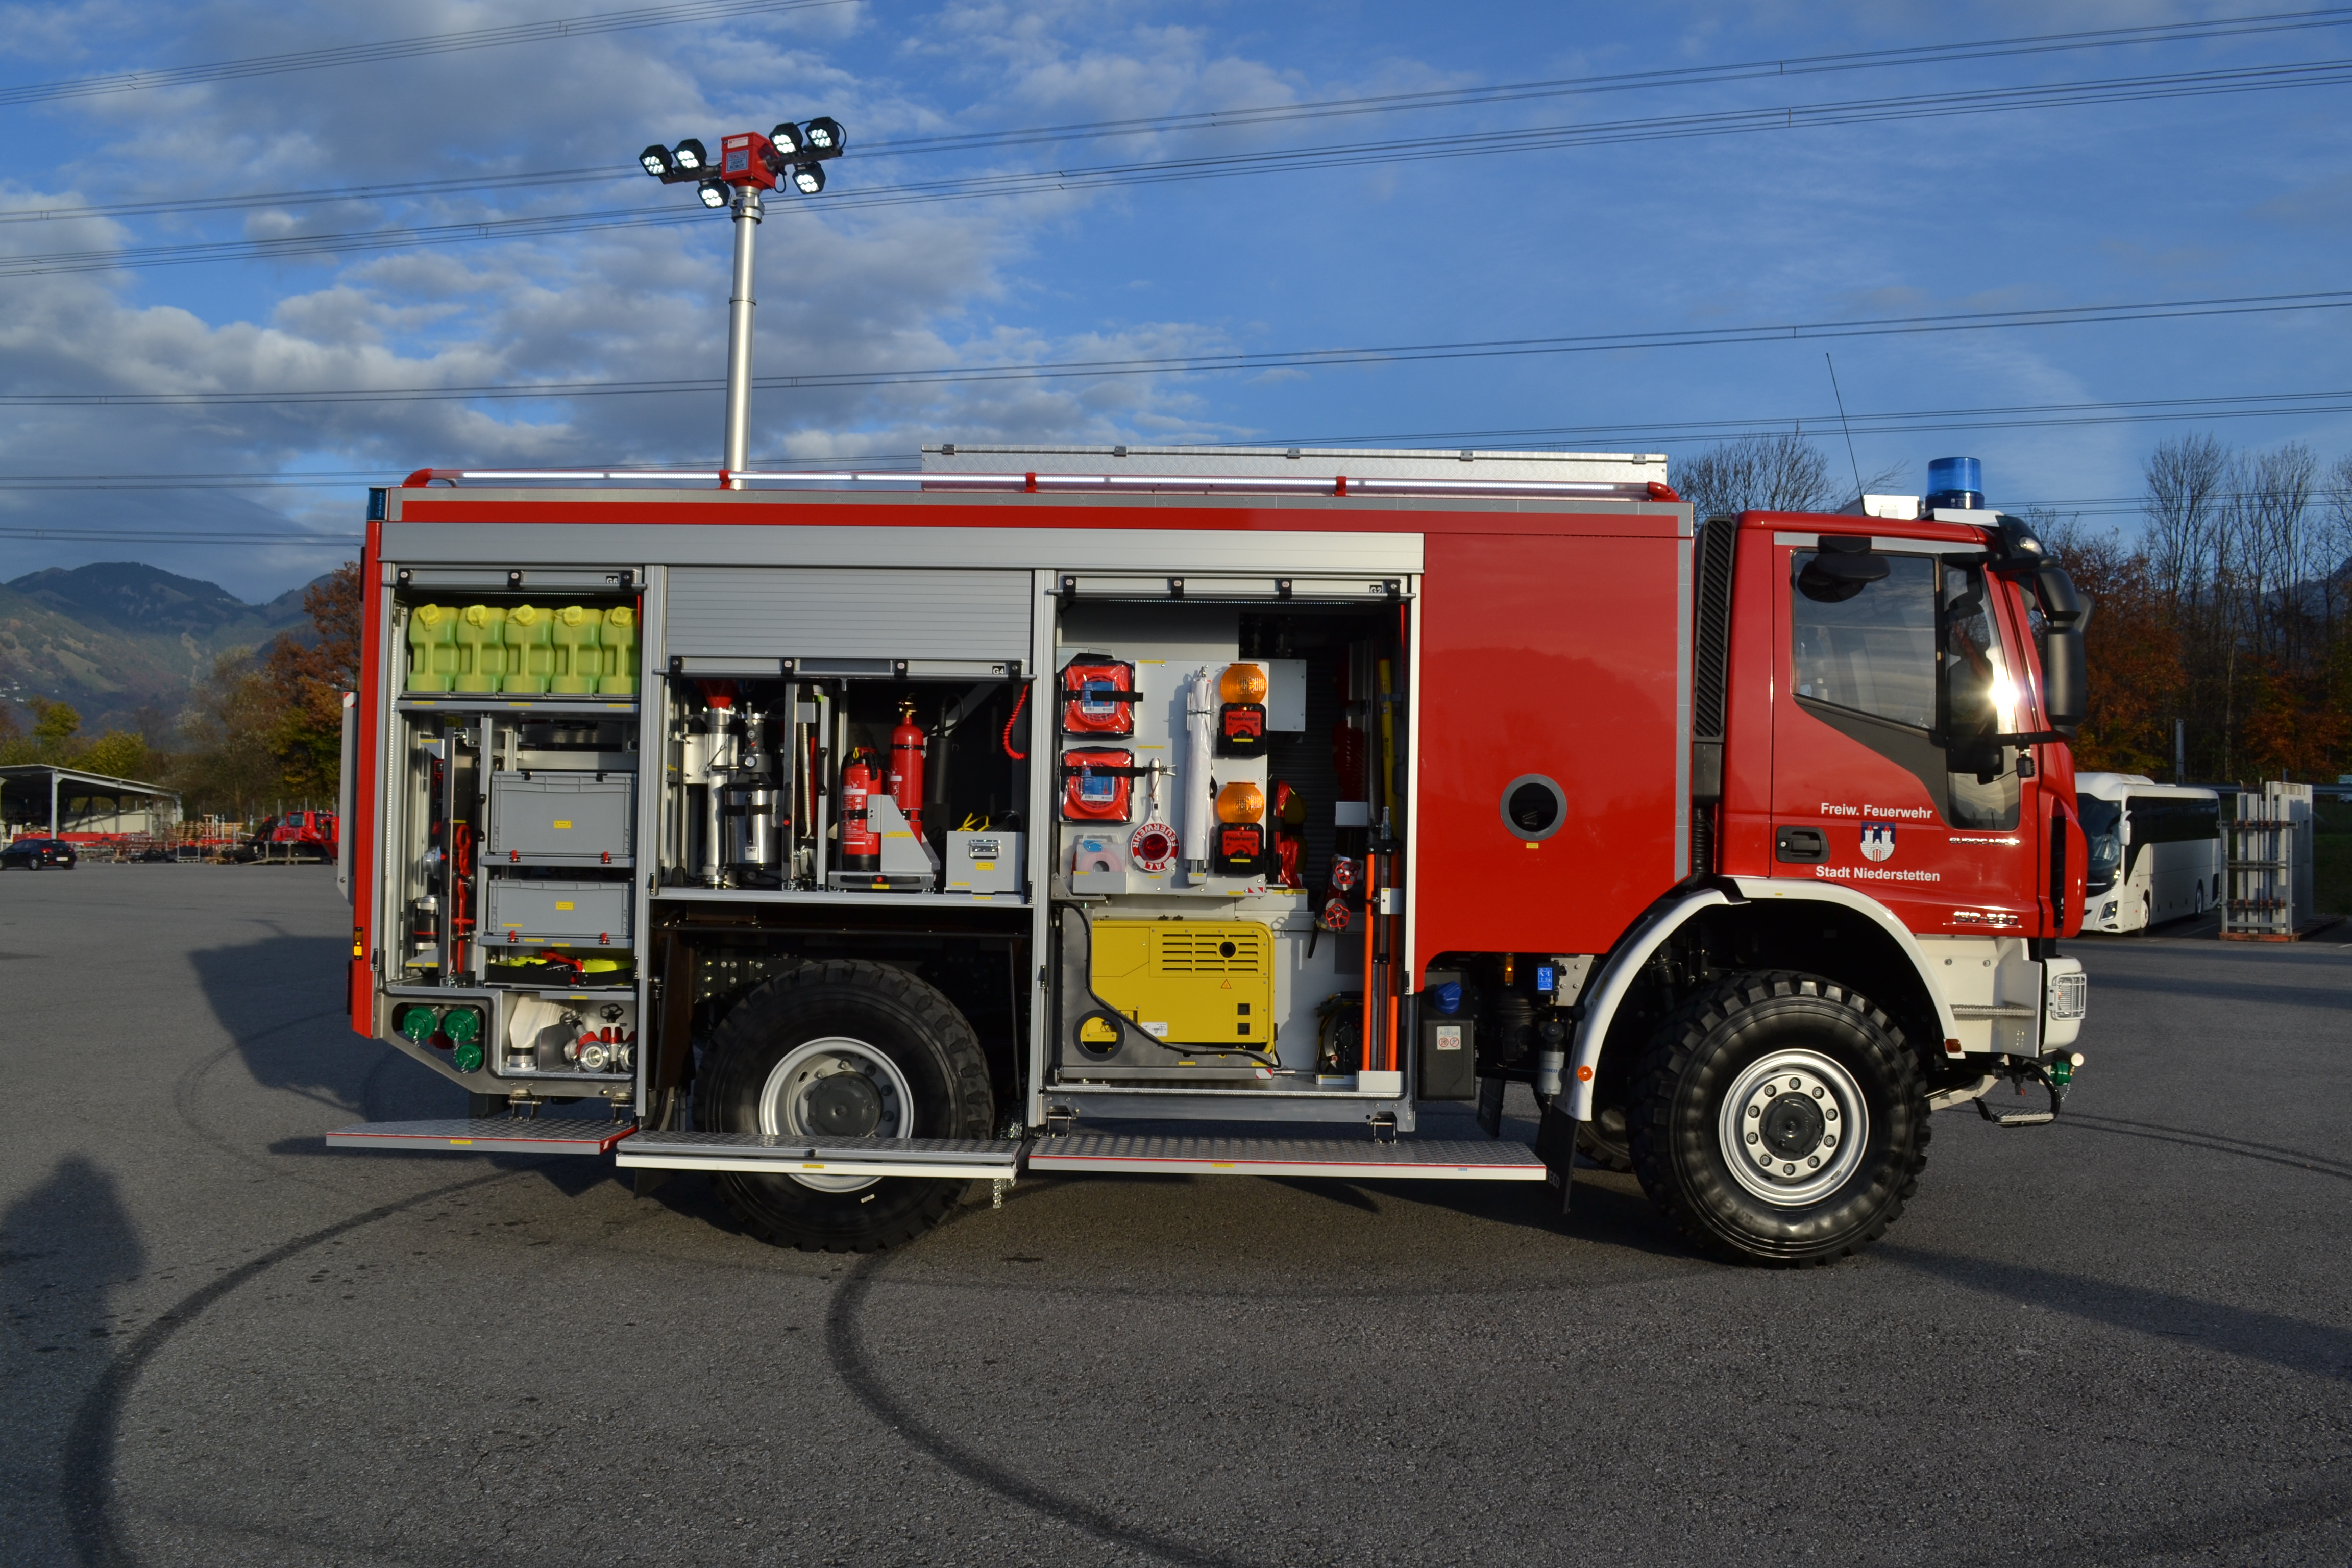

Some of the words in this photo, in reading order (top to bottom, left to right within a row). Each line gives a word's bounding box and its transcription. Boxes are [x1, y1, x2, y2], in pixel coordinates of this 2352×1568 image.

[1821, 803, 1859, 816] Freiw.
[1864, 804, 1932, 819] Feuerwehr
[1133, 824, 1178, 848] FEUERWEHR
[1816, 866, 1850, 878] Stadt
[1854, 867, 1940, 882] Niederstetten
